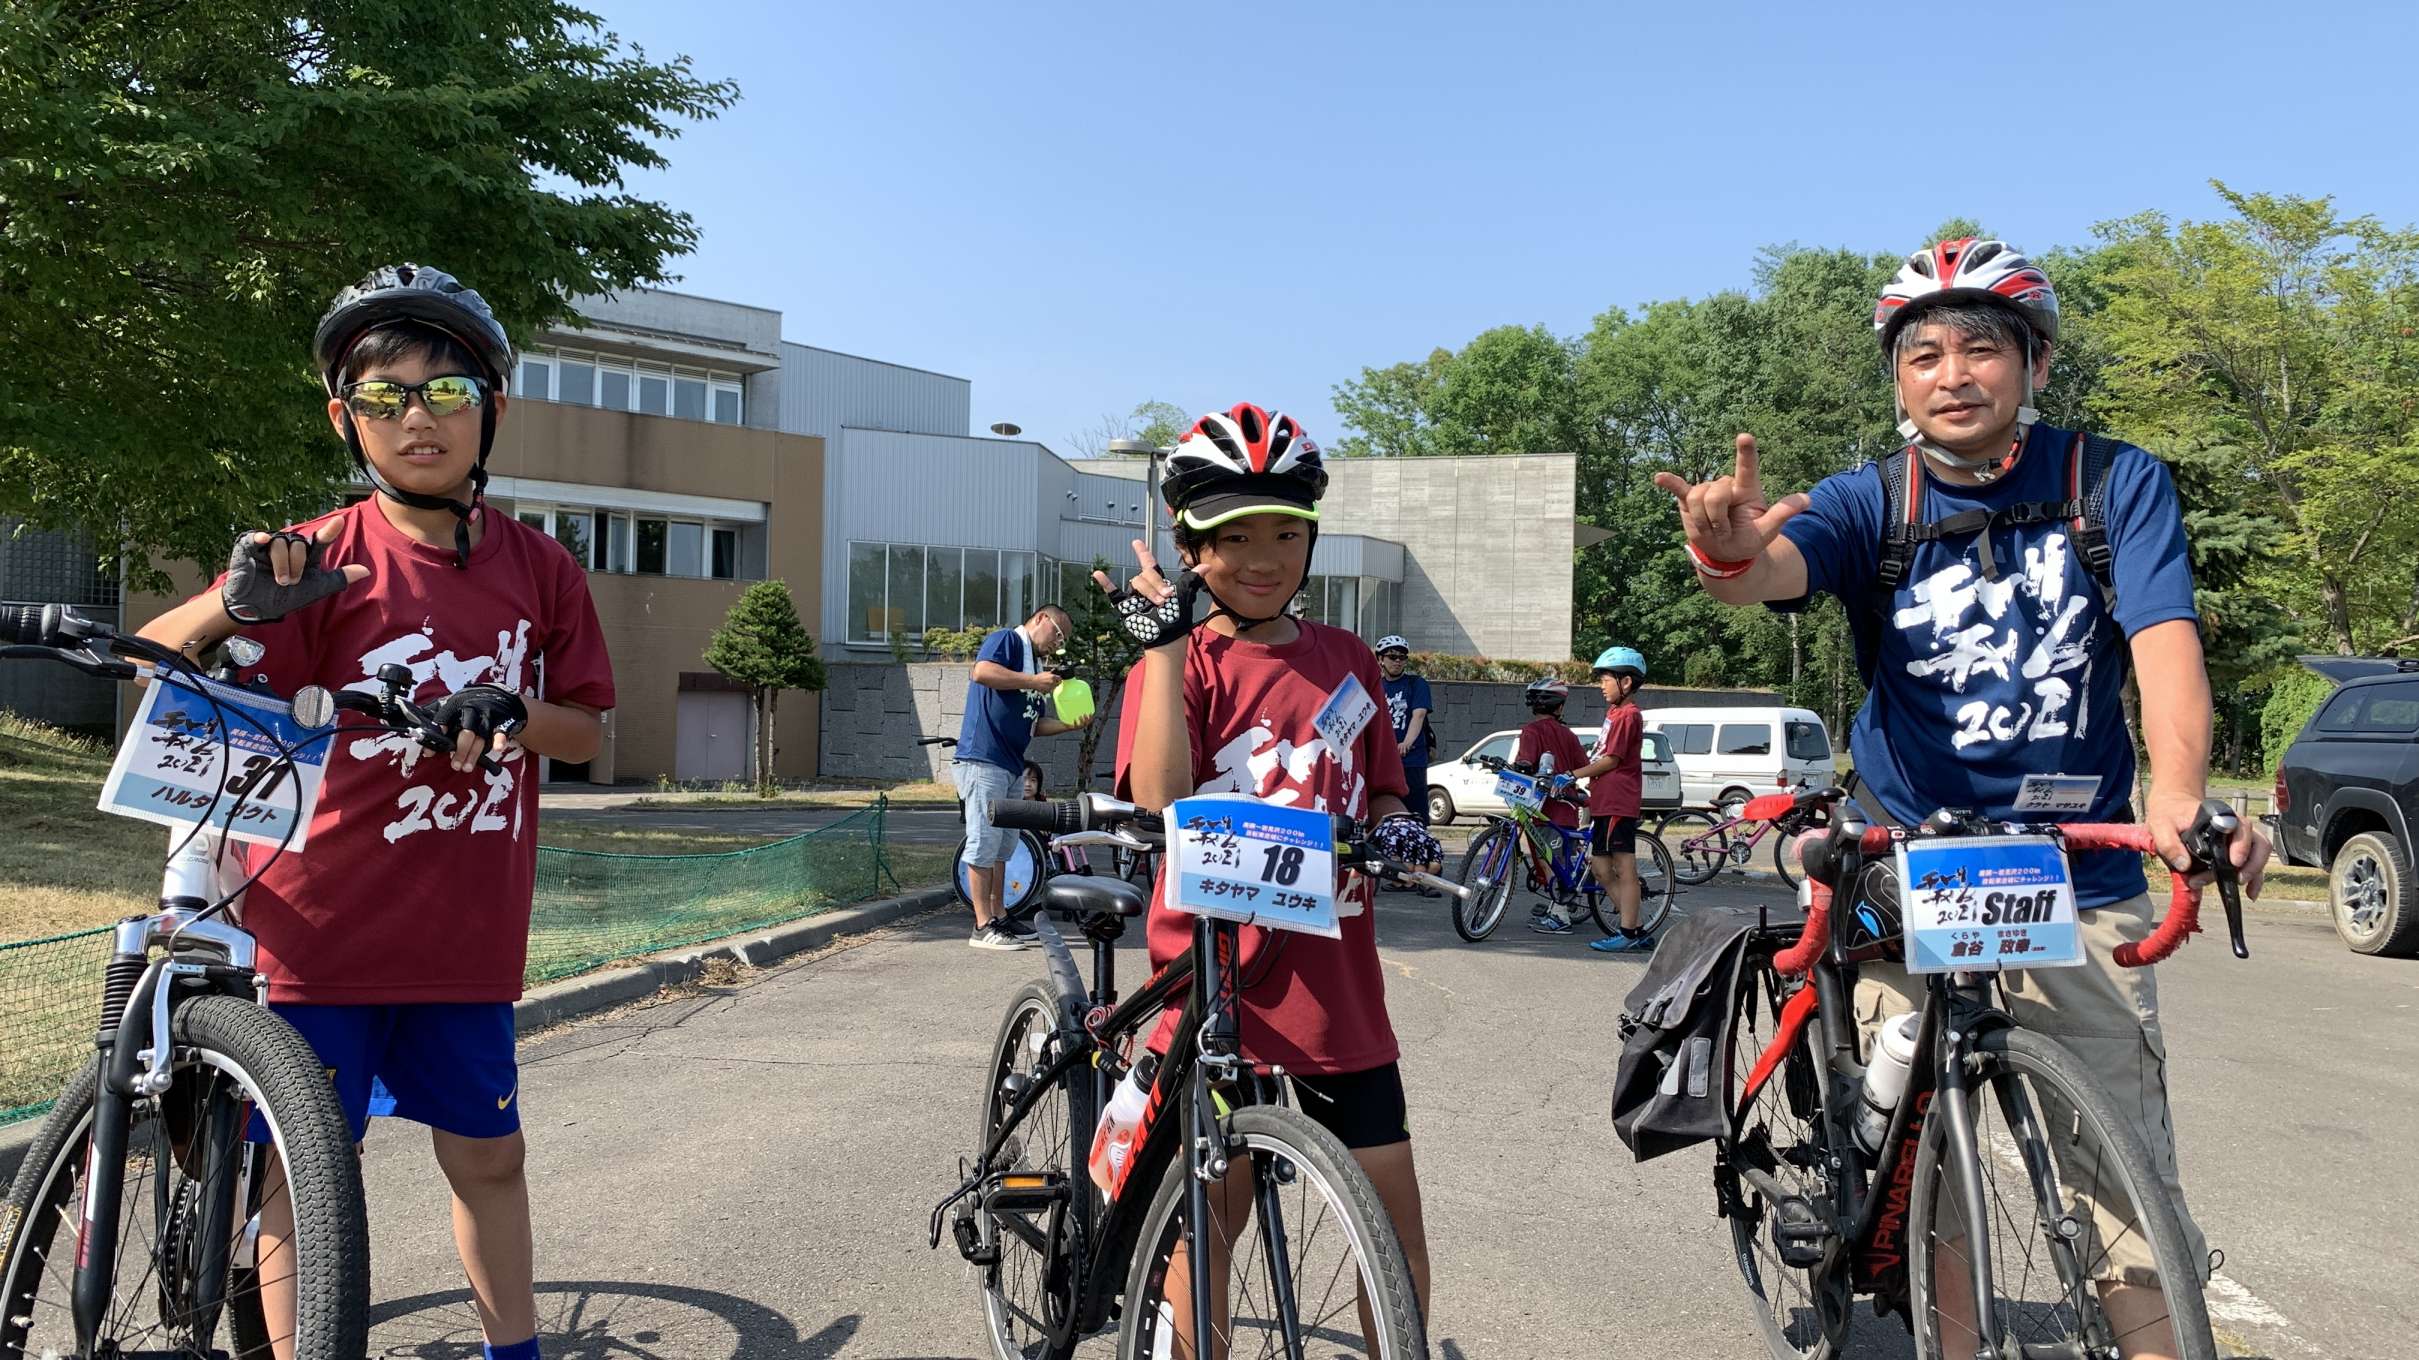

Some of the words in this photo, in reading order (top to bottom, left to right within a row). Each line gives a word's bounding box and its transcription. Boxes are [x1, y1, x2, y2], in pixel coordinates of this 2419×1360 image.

[1952, 660, 2092, 750] 2021
[157, 755, 215, 777] 2021
[226, 754, 291, 800] 31
[151, 785, 214, 808] ハルタ
[384, 756, 526, 844] 2021
[1513, 785, 1526, 795] 39
[1202, 849, 1240, 868] 2021
[1261, 844, 1305, 886] 18
[1199, 878, 1260, 901] キタヤマ
[1272, 891, 1317, 912] ユウキ
[1982, 889, 2057, 925] Staff
[1937, 900, 1977, 924] 2021
[1951, 931, 1980, 939] くらや
